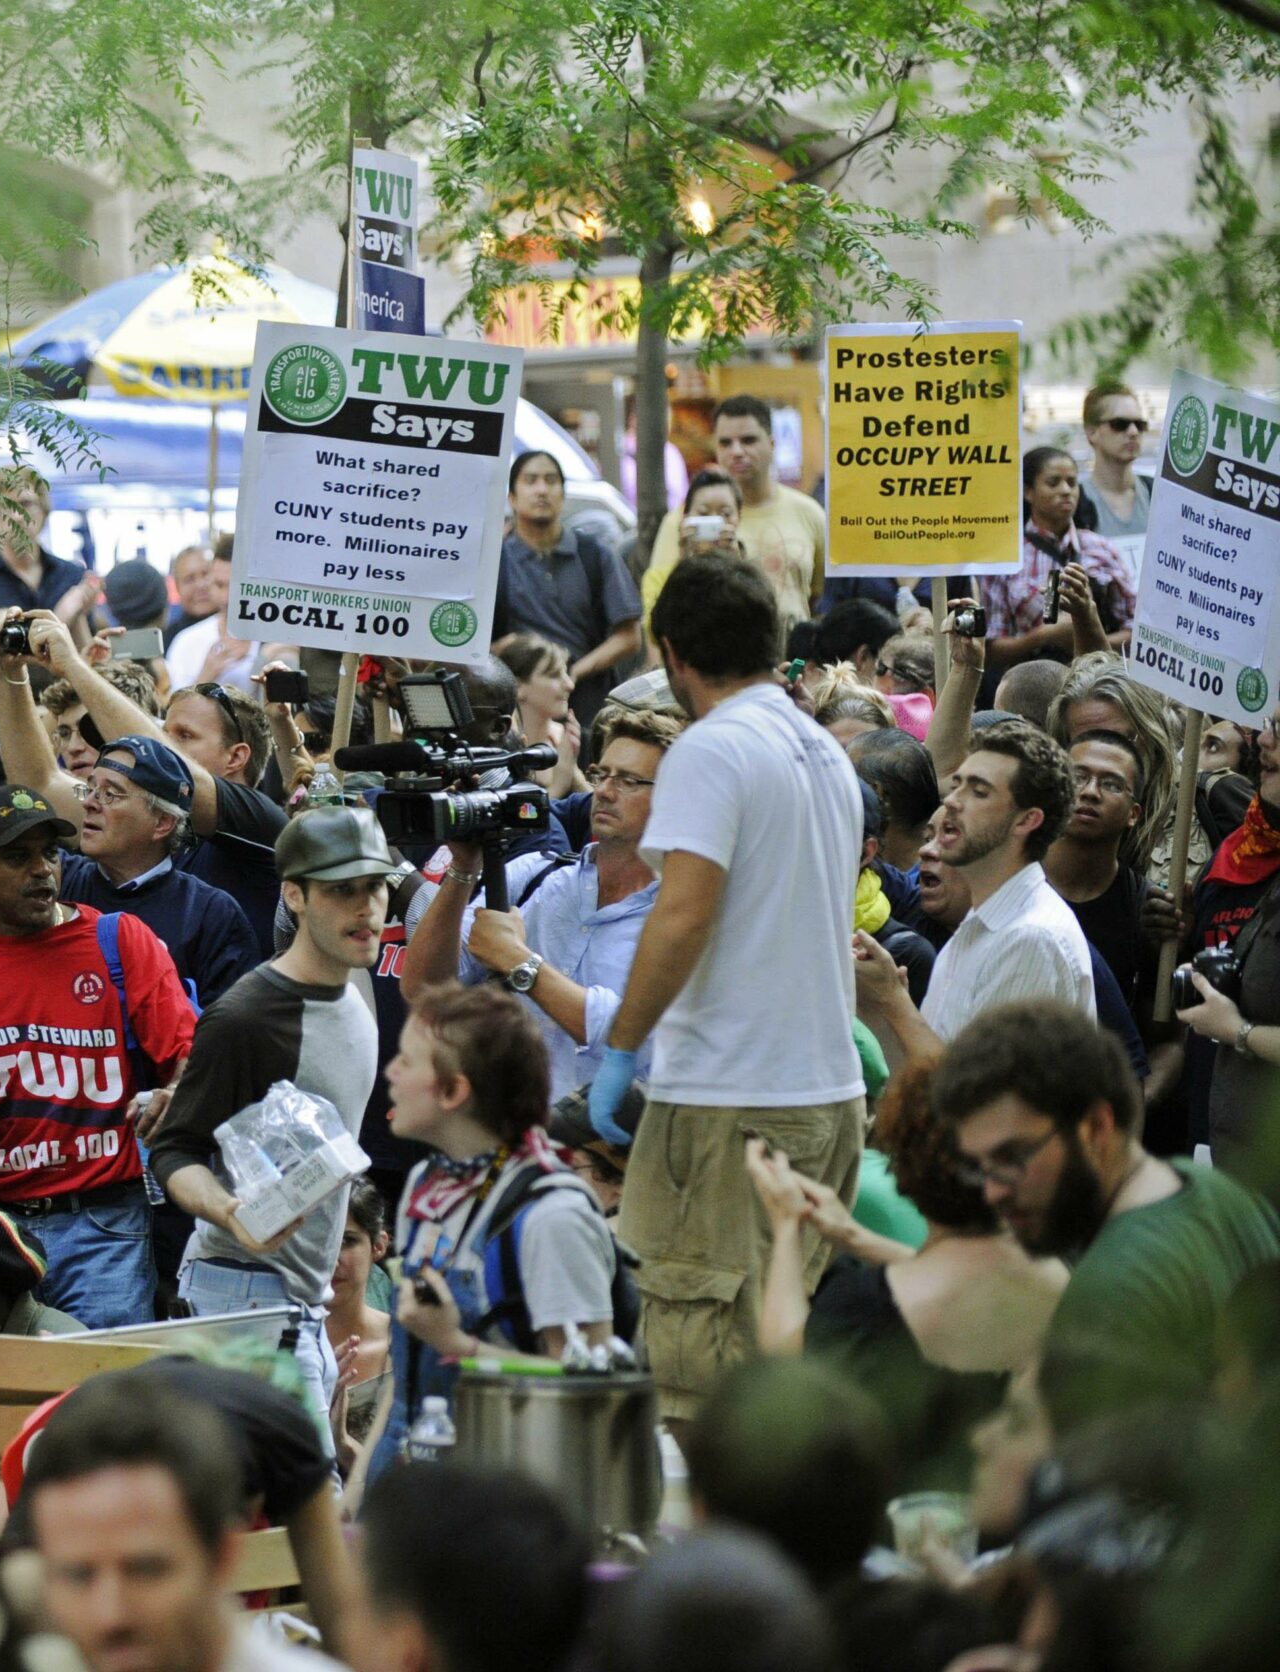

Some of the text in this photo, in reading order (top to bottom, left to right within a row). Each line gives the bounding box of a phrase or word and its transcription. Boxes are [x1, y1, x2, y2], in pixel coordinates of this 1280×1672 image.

[356, 218, 404, 262] Says
[357, 291, 405, 322] merica
[270, 347, 341, 399] TRANSPORT WORKERS
[837, 346, 1009, 369] Prostesters
[351, 348, 510, 405] TWU
[834, 378, 1005, 405] Have Rights
[371, 404, 474, 448] Says
[863, 413, 970, 437] Defend
[1212, 404, 1280, 464] TW
[316, 450, 441, 478] What shared
[836, 445, 1012, 466] OCCUPY WALL
[323, 479, 422, 502] sacrifice?
[879, 476, 971, 497] STREET
[1215, 459, 1280, 511] Says
[274, 500, 468, 540] CUNY students pay
[840, 515, 1009, 528] Bail Out the People Movement
[874, 529, 975, 540] BailOutPeople.org
[1181, 503, 1252, 542] What shared
[275, 528, 461, 562] more. Millionaires
[1182, 534, 1238, 563] sacrifice?
[323, 561, 406, 582] pay less
[1157, 550, 1264, 606] CUNY students pay
[240, 583, 412, 613] TRANSPORT WORKERS UNION
[1156, 578, 1256, 627] more. Millionaires
[238, 600, 410, 638] LOCAL 100
[1176, 615, 1220, 641] pay less
[1138, 625, 1226, 674] TRANSPORT WORKERS UNION
[1135, 642, 1185, 683] LOCAL
[1189, 667, 1224, 697] 100
[28, 1023, 116, 1048] STEWARD
[75, 1129, 119, 1162] 100
